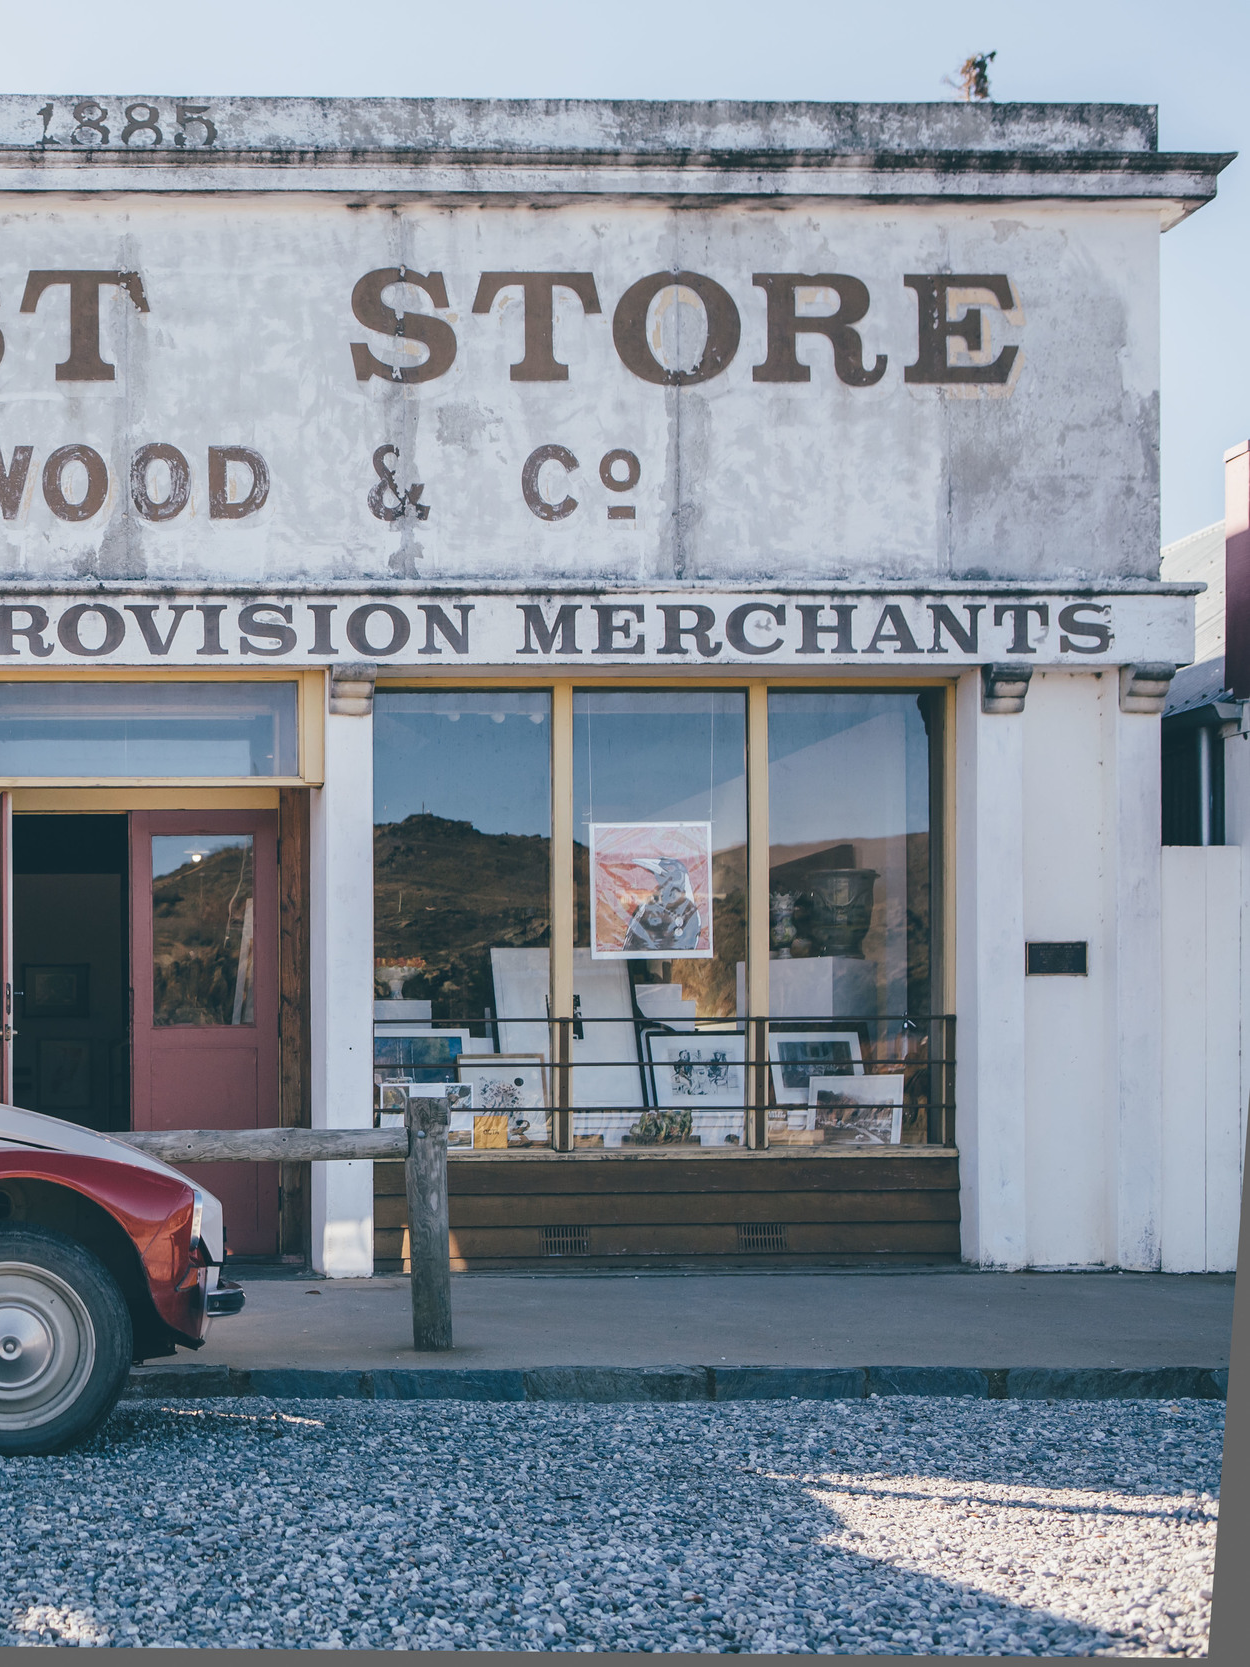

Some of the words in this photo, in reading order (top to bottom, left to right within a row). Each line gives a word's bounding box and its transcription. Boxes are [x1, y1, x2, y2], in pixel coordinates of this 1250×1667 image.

[38, 101, 218, 146] 1885
[350, 265, 1020, 387] STORE
[366, 444, 431, 522] &
[515, 602, 1116, 656] MERCHANTS
